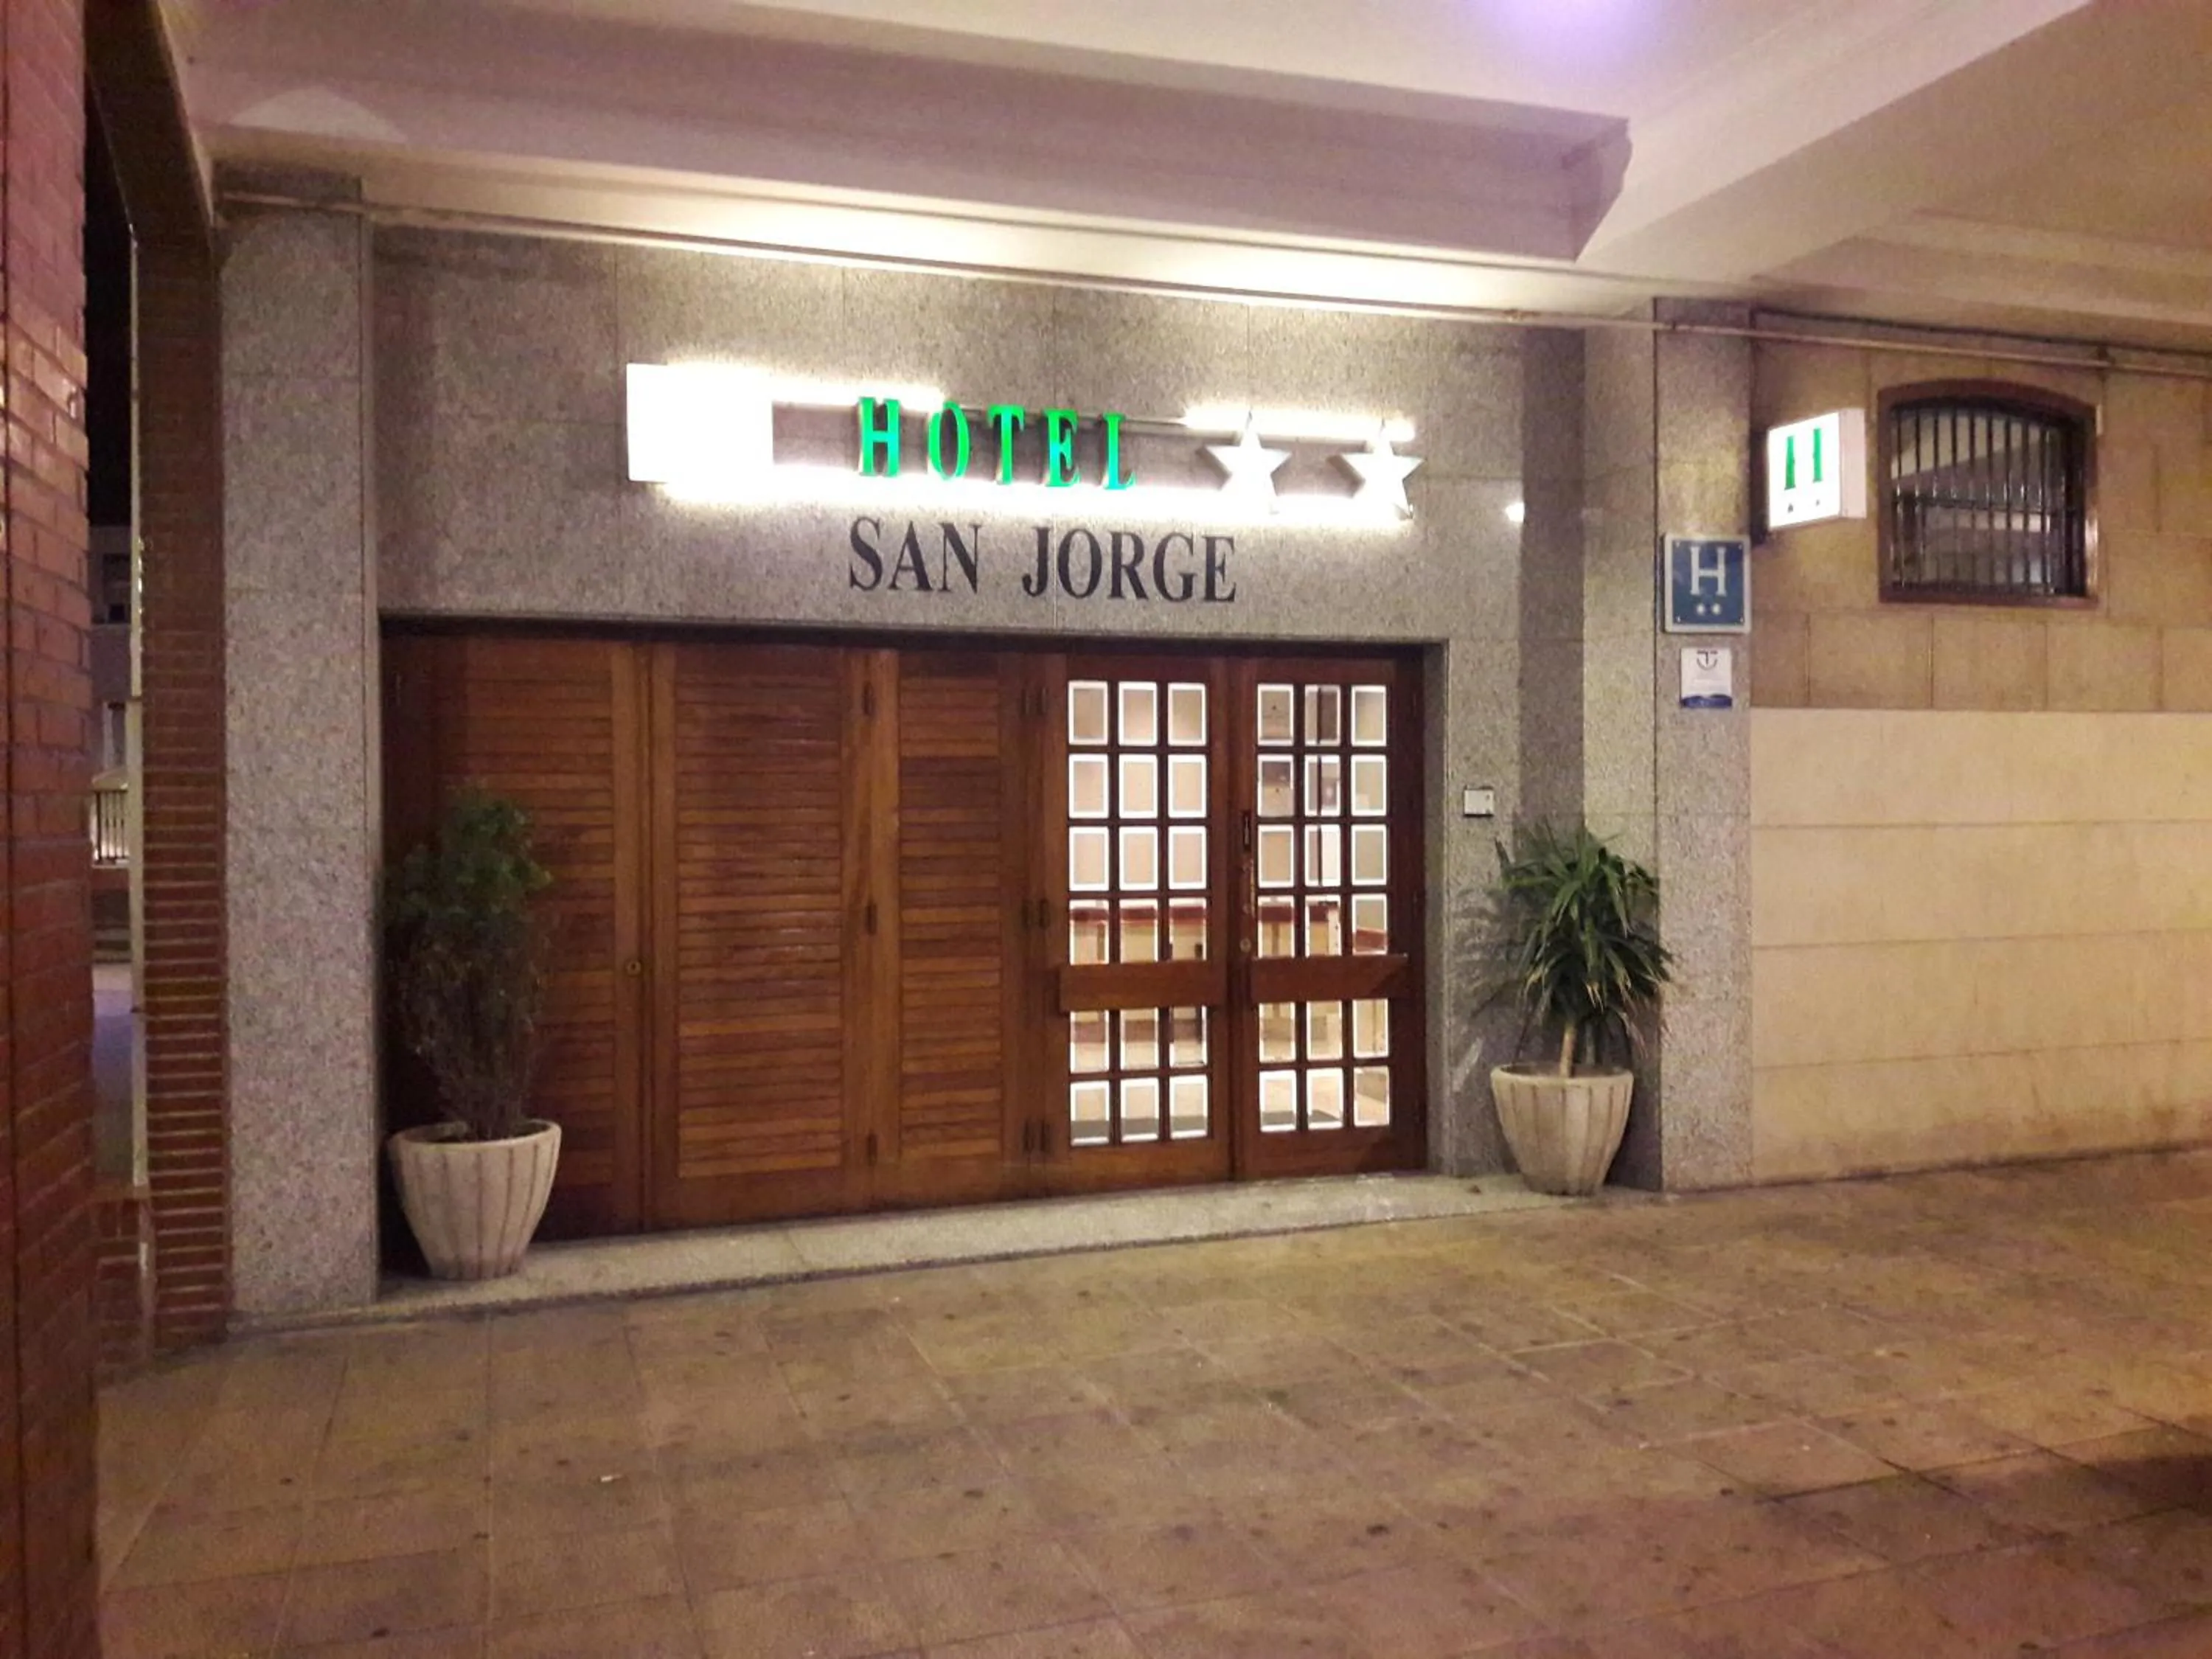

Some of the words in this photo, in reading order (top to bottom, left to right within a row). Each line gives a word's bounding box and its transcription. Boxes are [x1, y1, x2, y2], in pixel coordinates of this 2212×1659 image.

[859, 397, 1135, 490] HOTEL
[849, 517, 982, 593] SAN
[1022, 526, 1237, 602] JORGE
[1690, 546, 1727, 596] H
